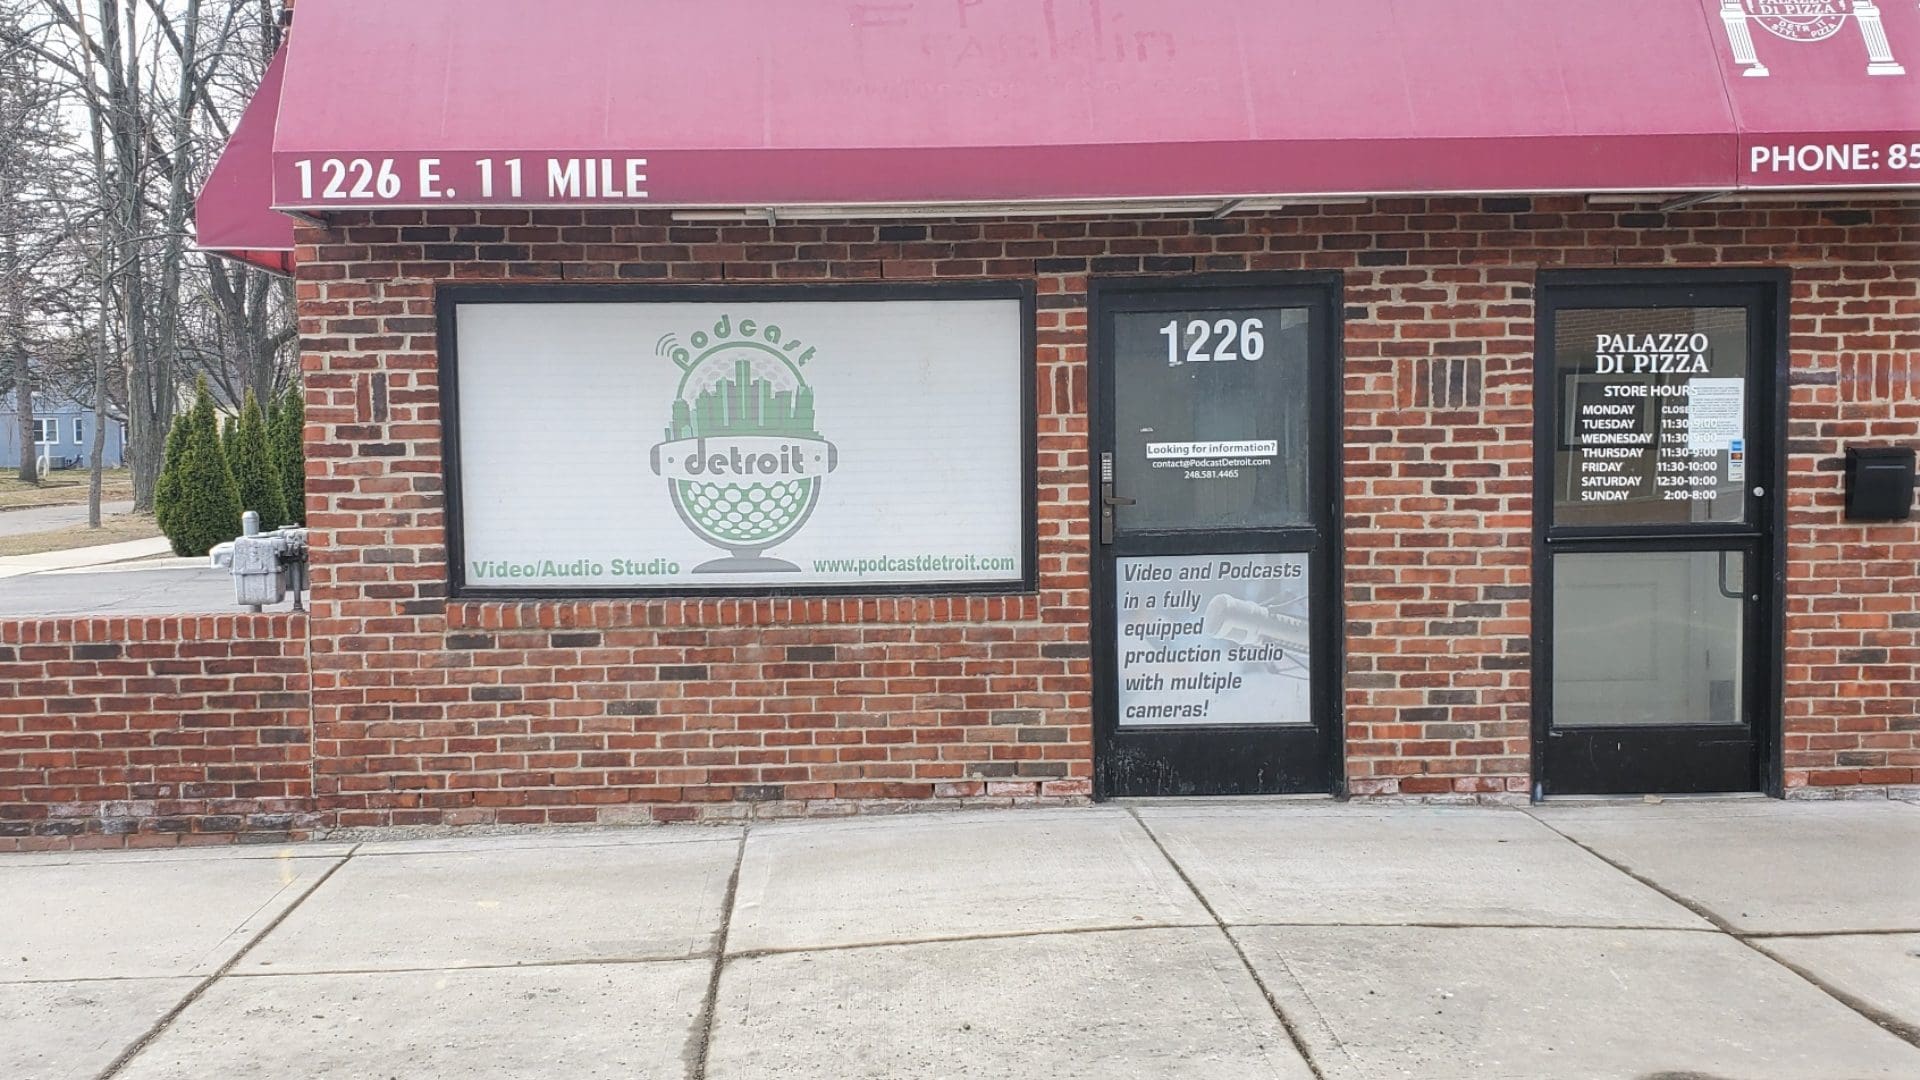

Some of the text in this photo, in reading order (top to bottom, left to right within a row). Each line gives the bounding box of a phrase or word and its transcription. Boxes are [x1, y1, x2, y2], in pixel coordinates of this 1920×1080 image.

[1784, 4, 1836, 14] PIZZA
[1751, 143, 1879, 172] PHONE:
[295, 158, 649, 199] 1226 E. 11 MILE
[672, 314, 816, 371] podcast
[1159, 318, 1265, 362] 1226
[1596, 333, 1709, 353] PALAZZO
[1596, 354, 1709, 374] DI PIZZA
[1604, 385, 1697, 397] STORE HOURS
[1583, 405, 1635, 415] MONDAY
[1583, 419, 1635, 429] TUESDAY
[1148, 442, 1276, 455] Looking for information?
[1582, 433, 1653, 444] WEDNESDAY
[685, 438, 804, 475] detroit
[1583, 448, 1718, 458] THURSDAY 11:30-9:00
[1184, 470, 1239, 479] 248.581.4465
[1582, 462, 1718, 472] FRIDAY 11:30-10:00
[1581, 476, 1717, 486] SATURDAY 12:30-10:00
[1581, 490, 1717, 501] SUNDAY 2:00-8:00
[472, 558, 680, 578] Video/Audio Studio
[813, 554, 1014, 576] www.podcastdetroit.com
[1124, 561, 1302, 582] Video and Podcasts
[1124, 590, 1201, 612] in a fully
[1124, 617, 1205, 641] equipped
[1124, 643, 1283, 669] production studio
[1126, 672, 1242, 694] with multiple
[1126, 700, 1209, 719] cameras!
